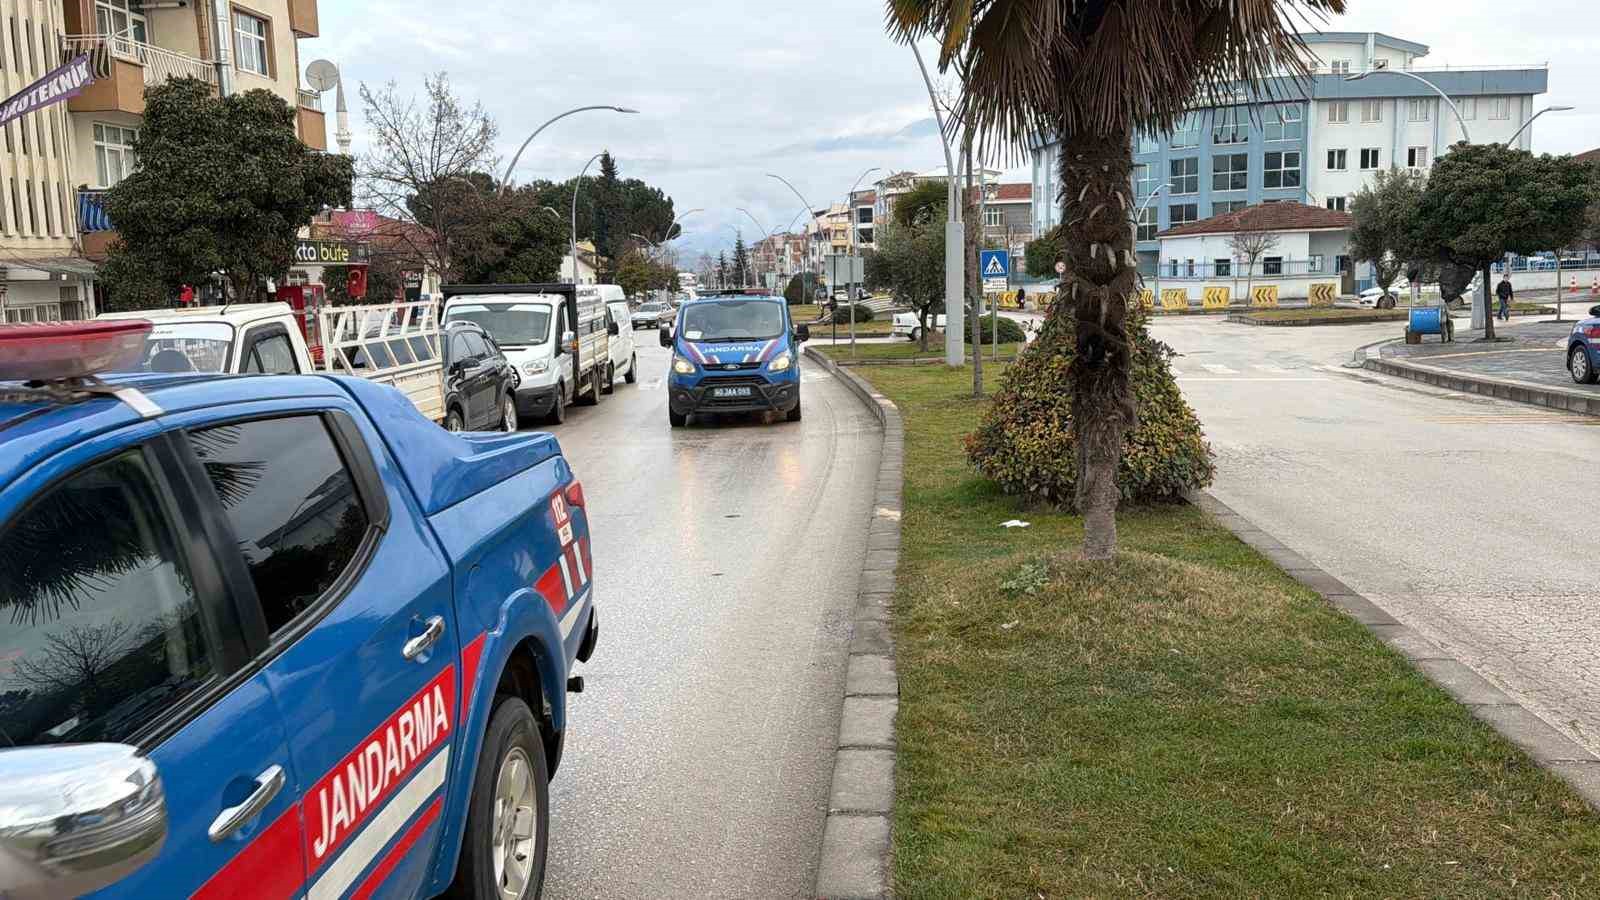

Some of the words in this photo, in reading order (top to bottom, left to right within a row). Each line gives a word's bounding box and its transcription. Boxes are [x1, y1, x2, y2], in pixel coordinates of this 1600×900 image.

[0, 61, 89, 121] İKOTEKNİK
[703, 345, 761, 354] JANDARMA
[551, 494, 568, 524] 112
[313, 684, 449, 858] JANDARMA
